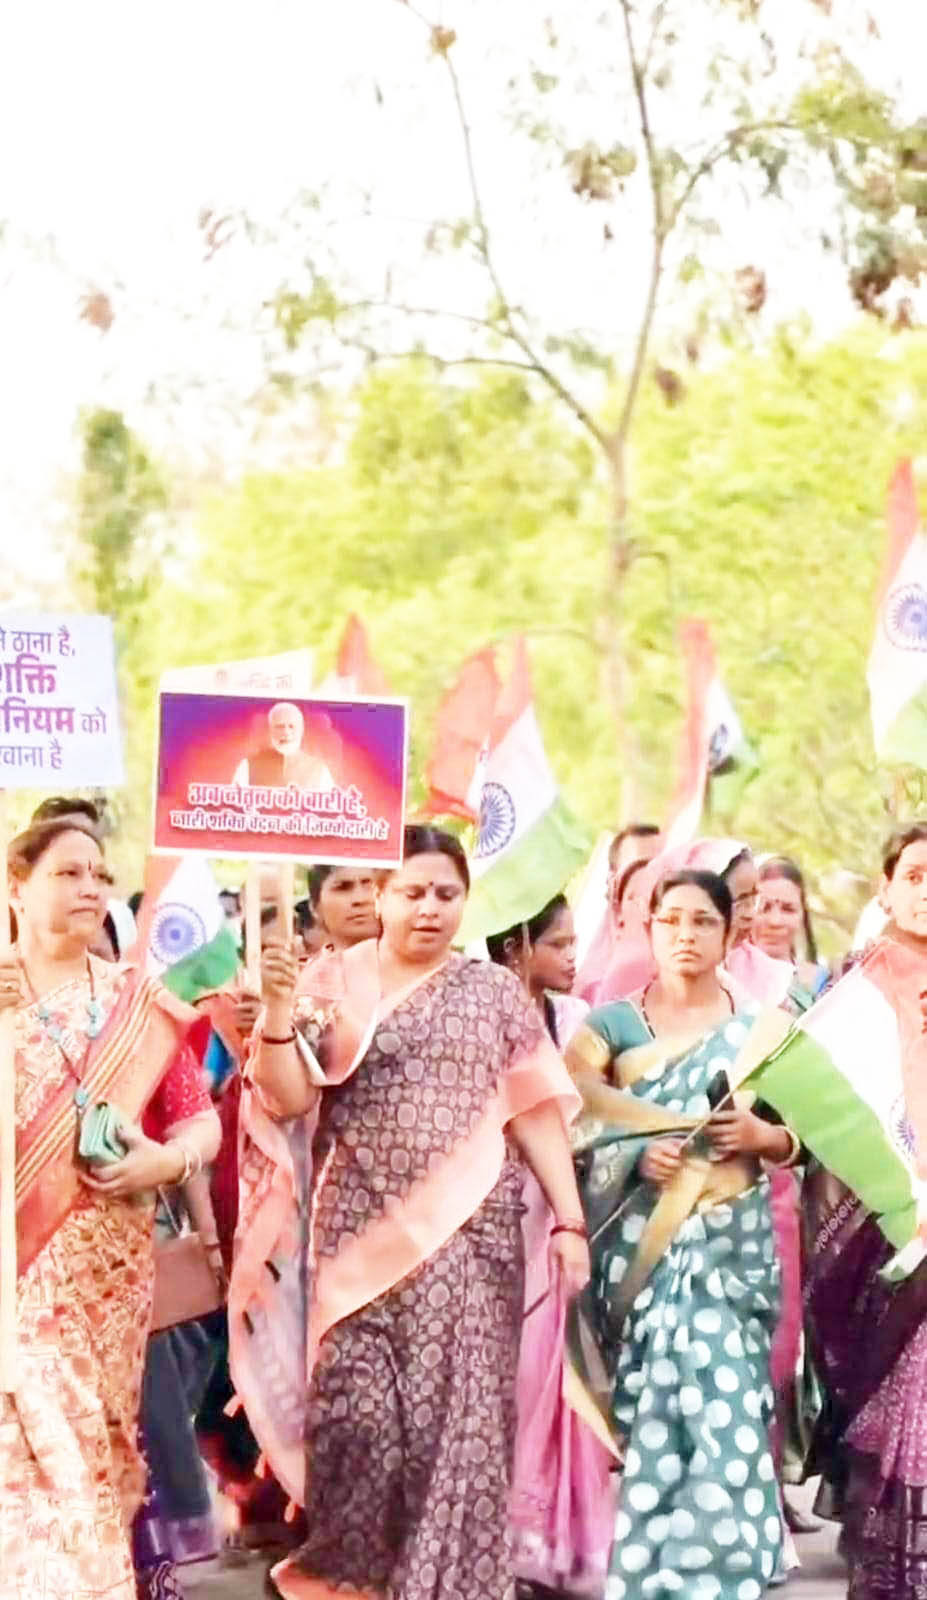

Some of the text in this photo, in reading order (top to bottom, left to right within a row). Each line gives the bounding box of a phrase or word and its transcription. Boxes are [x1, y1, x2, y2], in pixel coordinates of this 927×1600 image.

[10, 630, 53, 654] ठाना
[58, 624, 76, 656] है,
[0, 696, 108, 734] नियम को
[48, 736, 63, 770] है
[170, 808, 206, 829] नारी
[208, 808, 246, 831] शक्ति
